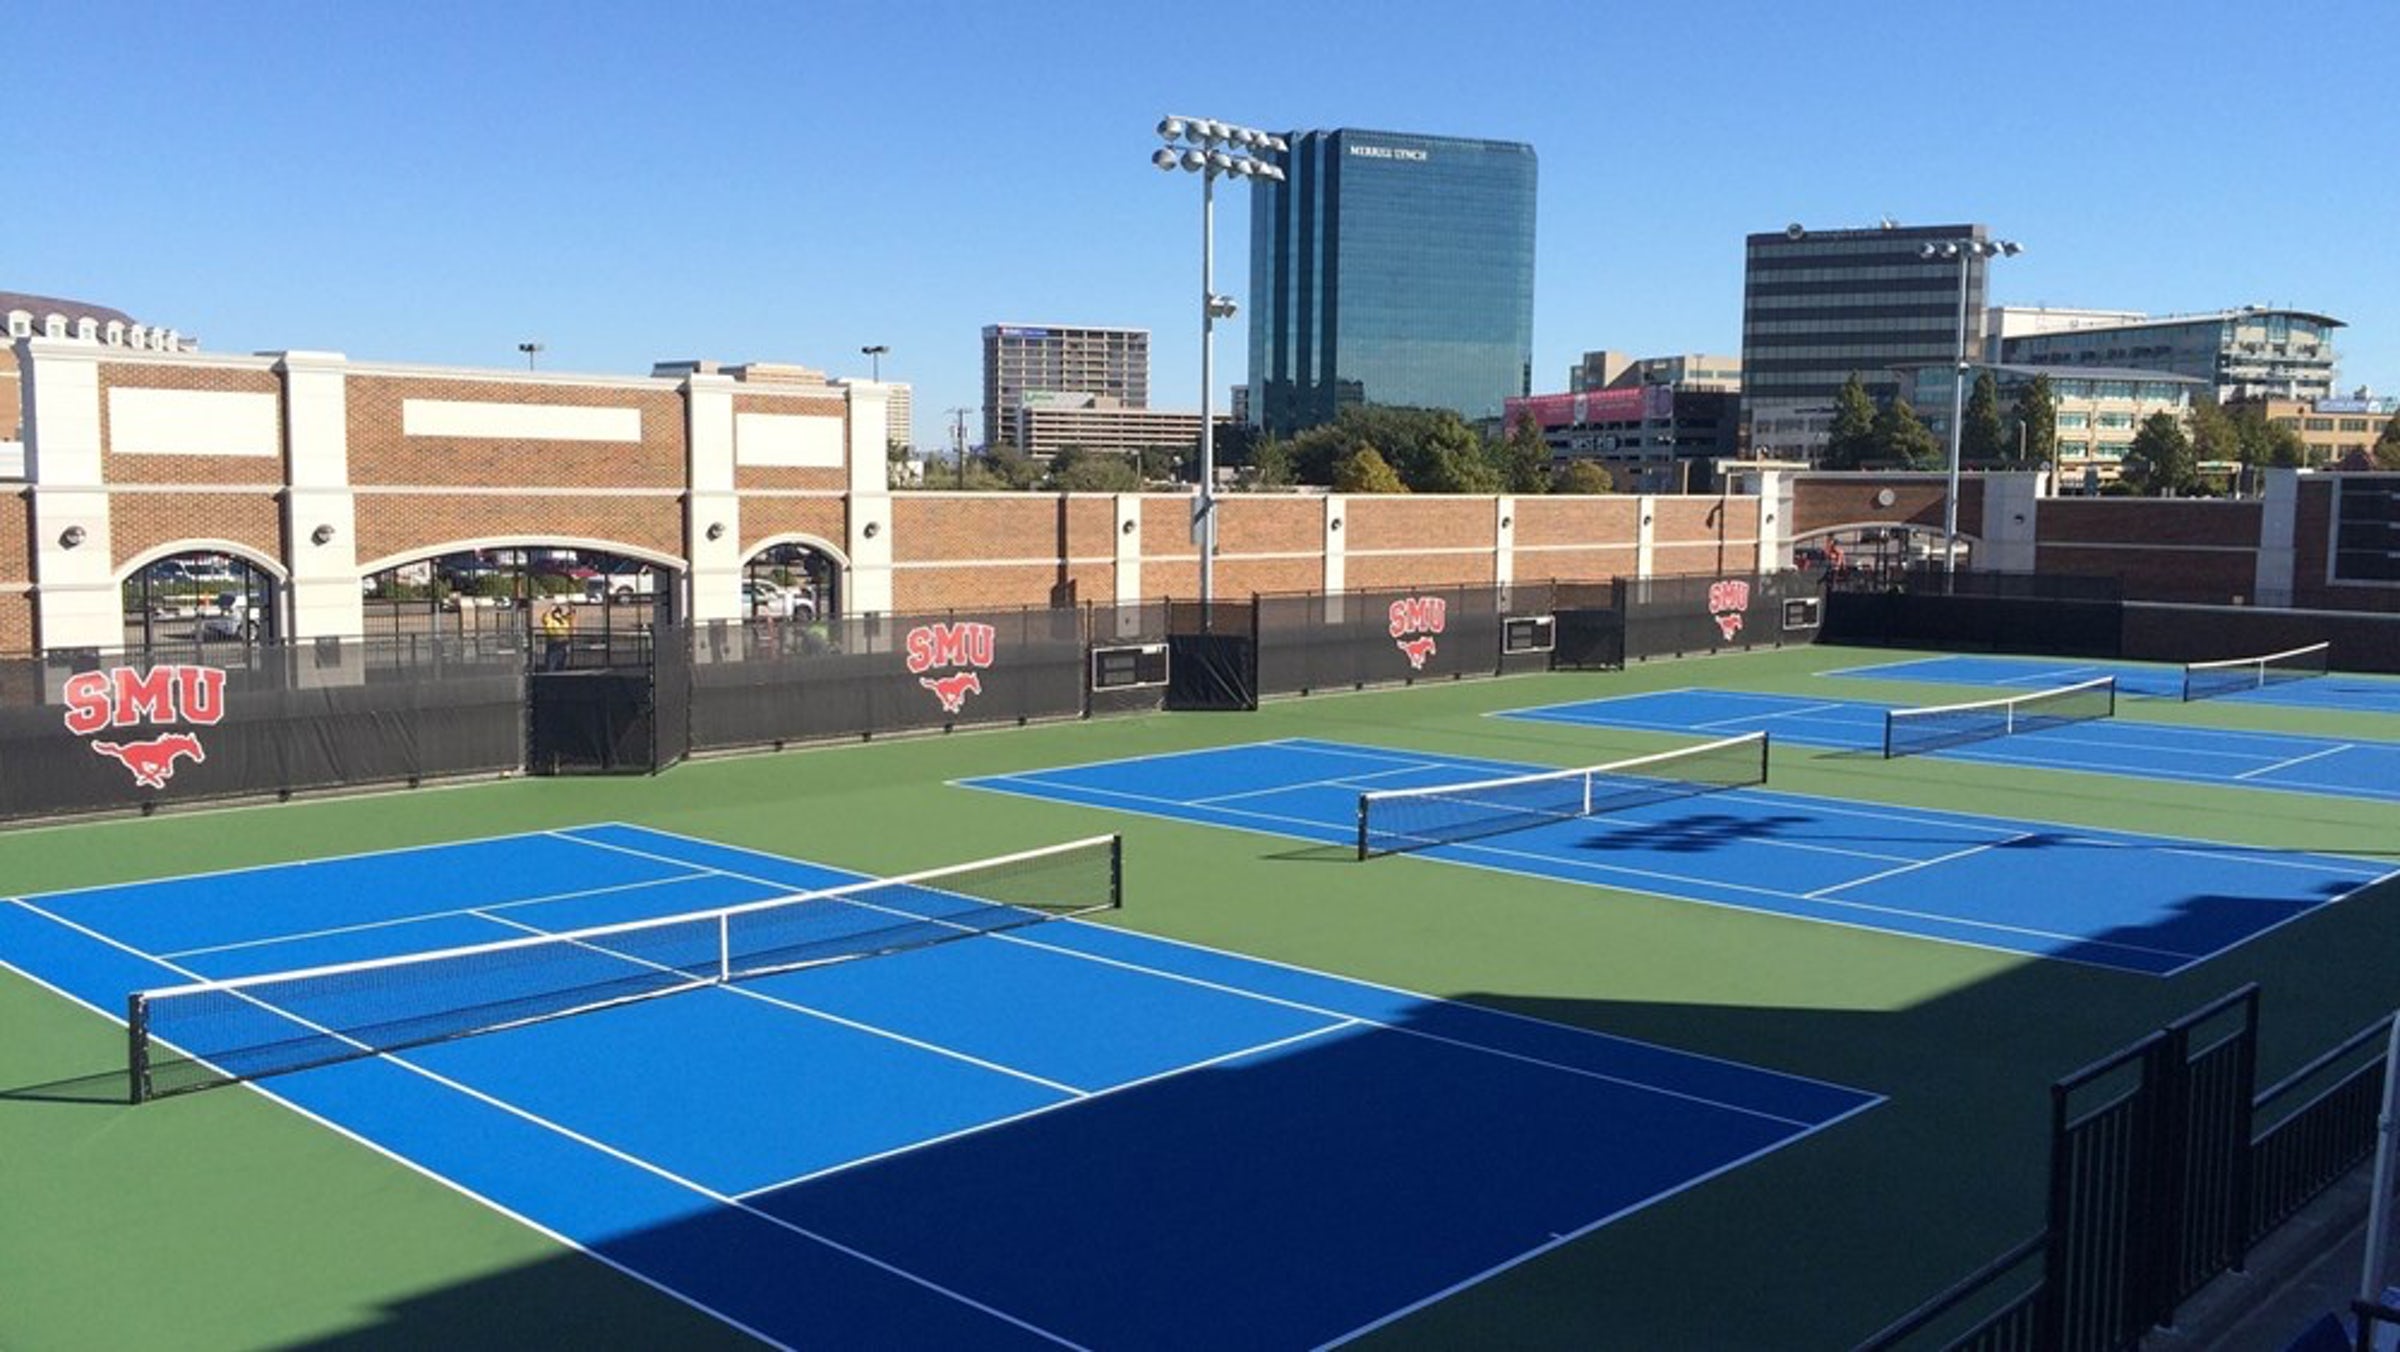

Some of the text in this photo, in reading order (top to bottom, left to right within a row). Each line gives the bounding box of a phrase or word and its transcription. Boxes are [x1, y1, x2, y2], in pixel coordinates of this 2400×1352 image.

[1389, 596, 1446, 638] SMU
[1709, 580, 1750, 615] SMU
[906, 622, 995, 673] SMU
[64, 665, 227, 736] SMU
